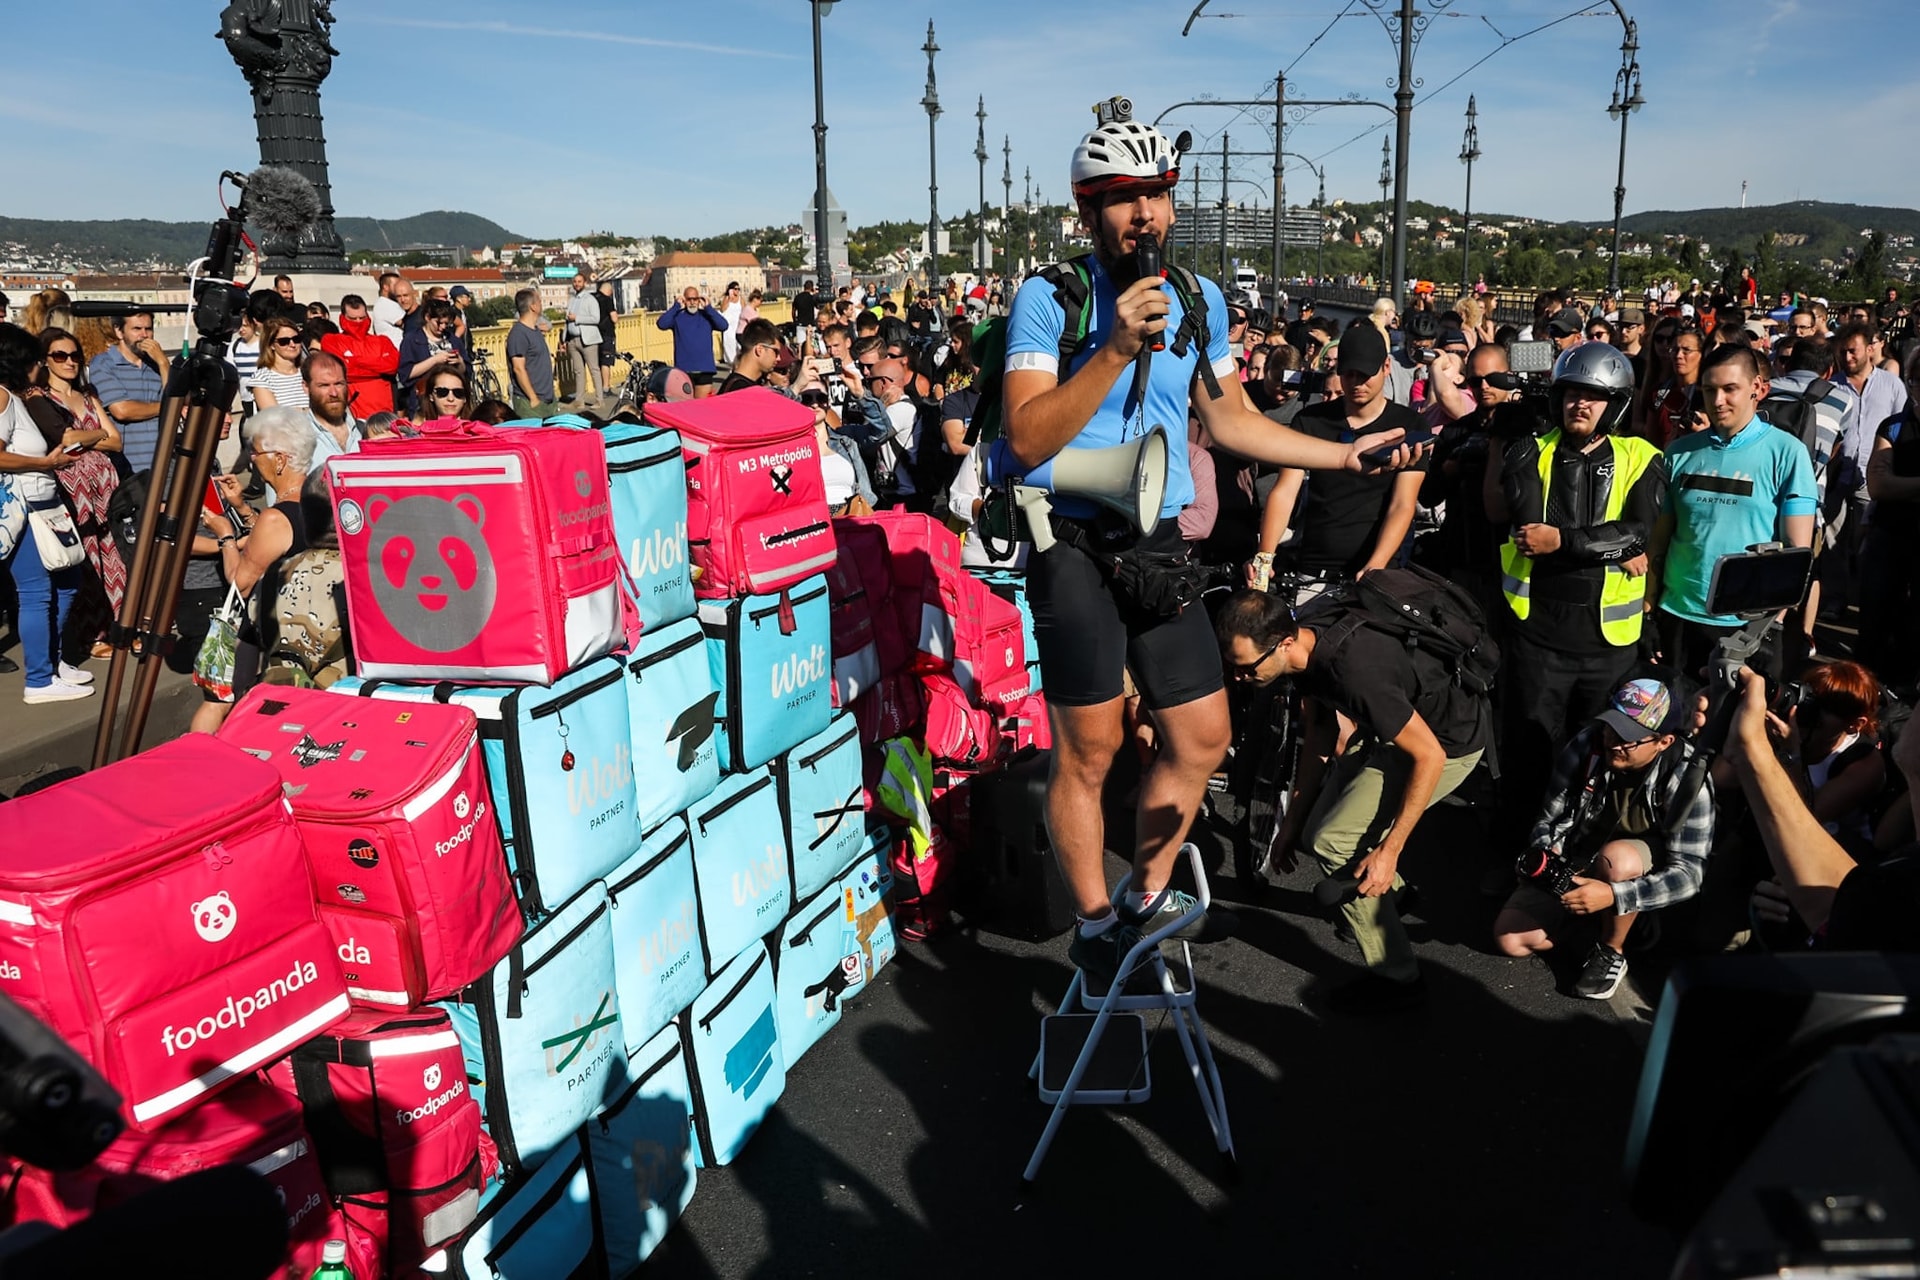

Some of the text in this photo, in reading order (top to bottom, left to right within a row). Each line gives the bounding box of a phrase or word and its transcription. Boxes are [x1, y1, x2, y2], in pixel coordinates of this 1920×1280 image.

[738, 446, 813, 474] M3 Metrópótló
[1696, 496, 1738, 506] PARTNER
[653, 576, 682, 596] PARTNE
[771, 644, 825, 698] Wolt
[786, 689, 816, 711] PARTNER
[687, 748, 713, 772] ARTNER
[567, 743, 631, 817] Wolt
[435, 802, 486, 857] foodpnda
[590, 800, 625, 830] PARTNER
[836, 827, 859, 850] PARTNER
[732, 844, 786, 906] Wolt
[756, 889, 783, 917] PARTNER
[639, 899, 695, 976] Wolt
[660, 950, 690, 984] PARTNER
[161, 960, 318, 1057] foodpanda
[567, 1040, 614, 1091] PARTNER
[396, 1079, 464, 1126] foodpanda
